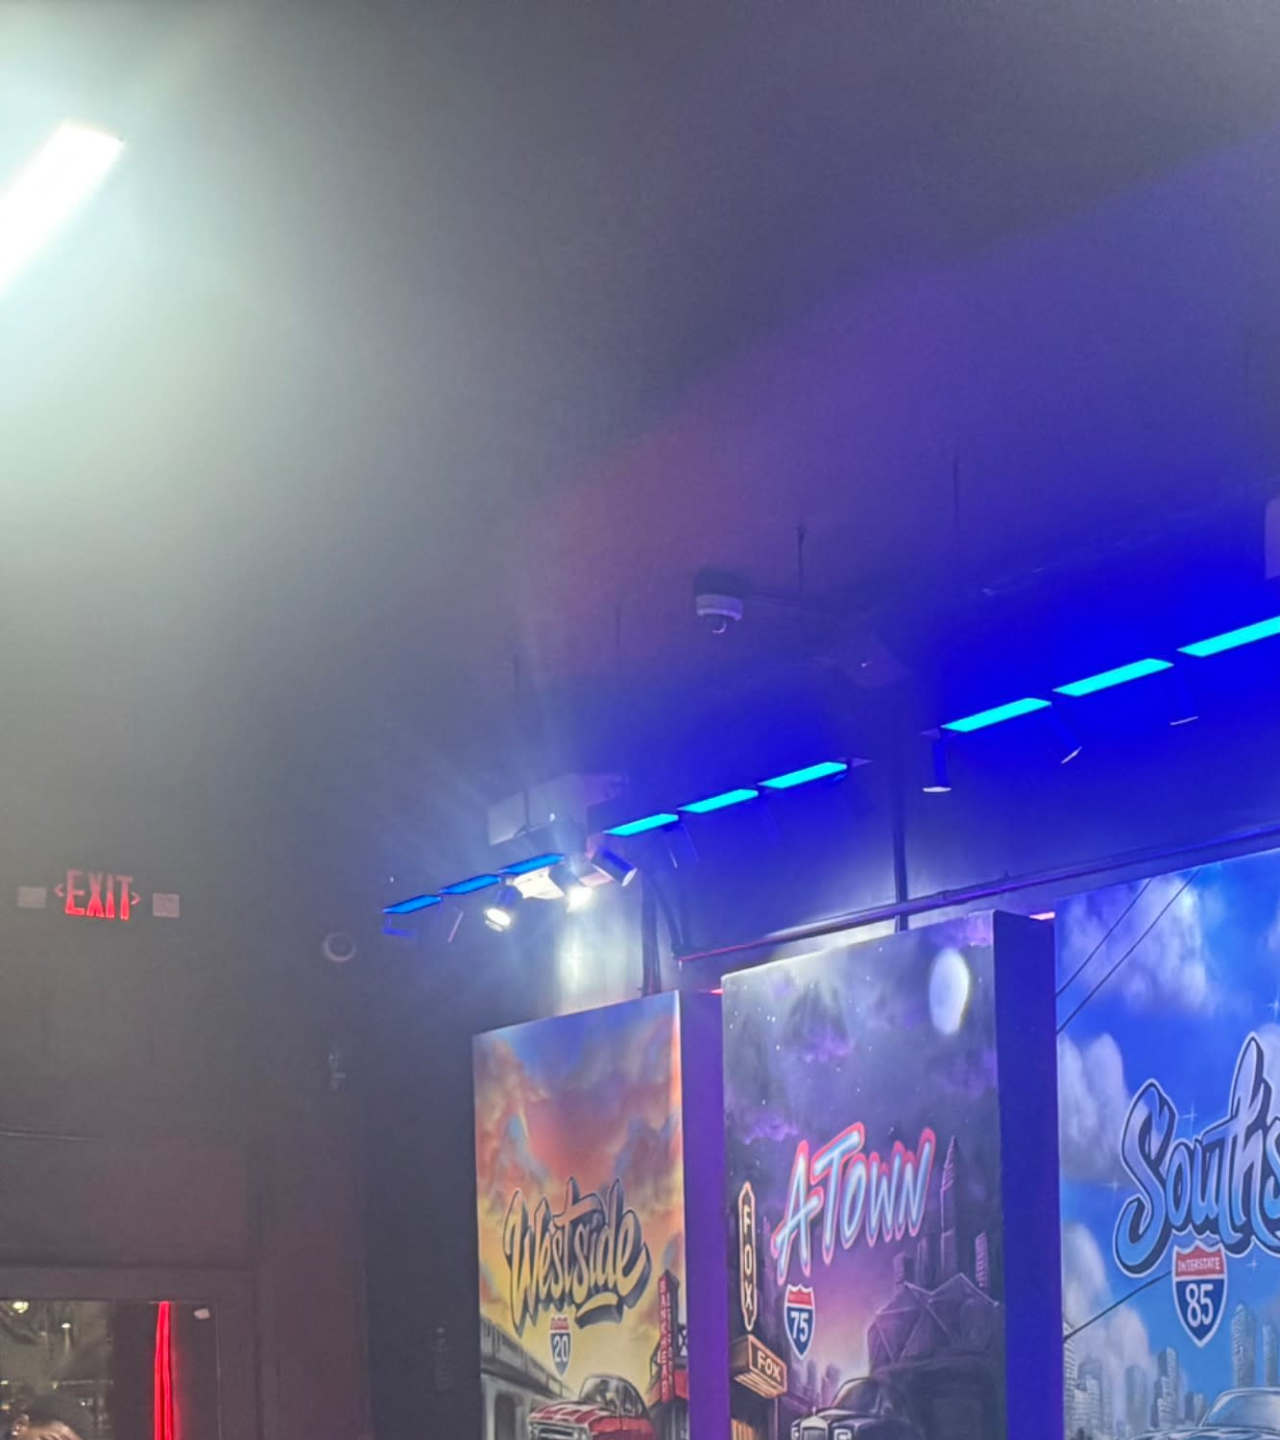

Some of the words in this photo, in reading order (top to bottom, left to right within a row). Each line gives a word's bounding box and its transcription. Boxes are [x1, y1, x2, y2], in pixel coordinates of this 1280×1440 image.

[64, 869, 133, 920] EXIT
[503, 1176, 652, 1340] Westside
[743, 1203, 753, 1311] FOX
[790, 1311, 808, 1342] 75
[1185, 1282, 1214, 1327] 85
[553, 1335, 568, 1362] 20
[757, 1351, 782, 1382] FOX
